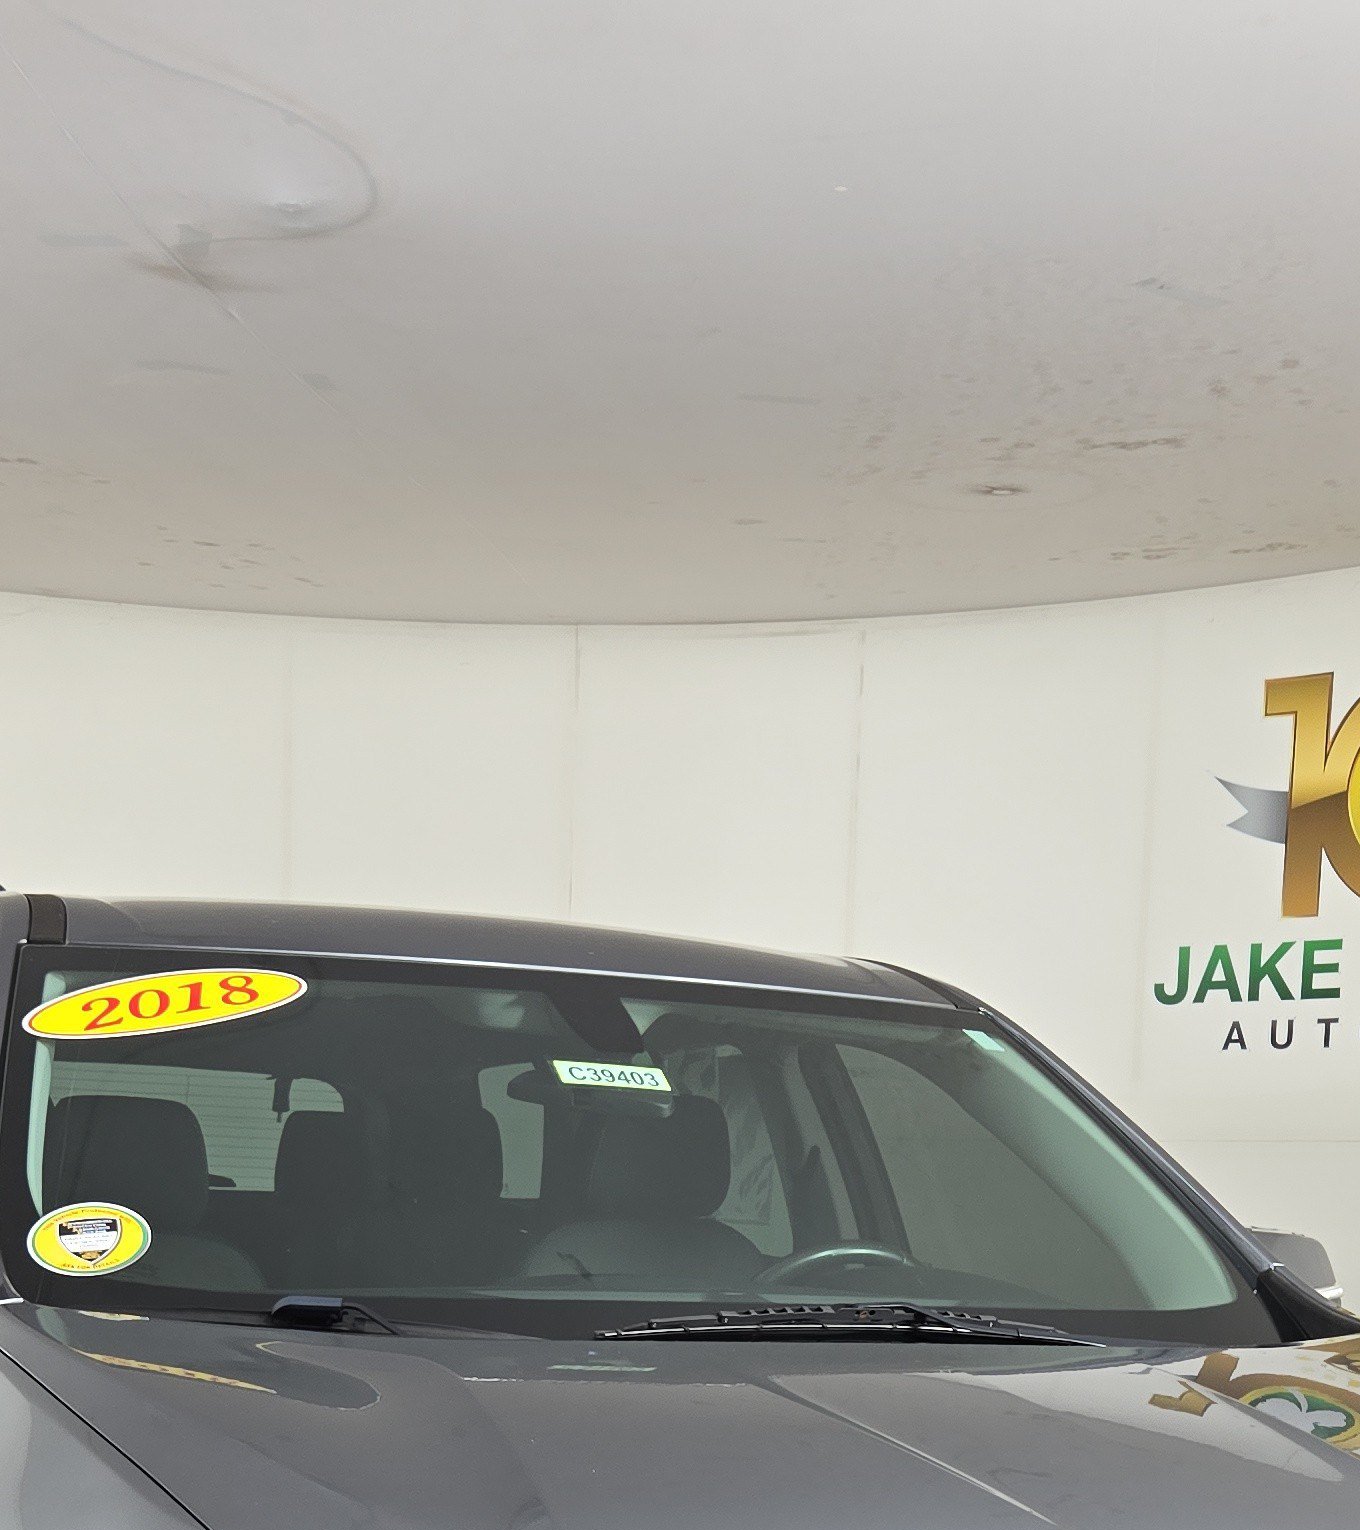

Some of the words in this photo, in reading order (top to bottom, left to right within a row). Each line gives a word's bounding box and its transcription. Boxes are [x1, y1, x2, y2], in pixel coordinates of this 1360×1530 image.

[1153, 938, 1344, 1006] JAKE
[80, 973, 261, 1032] 2018
[568, 1065, 661, 1089] C39403
